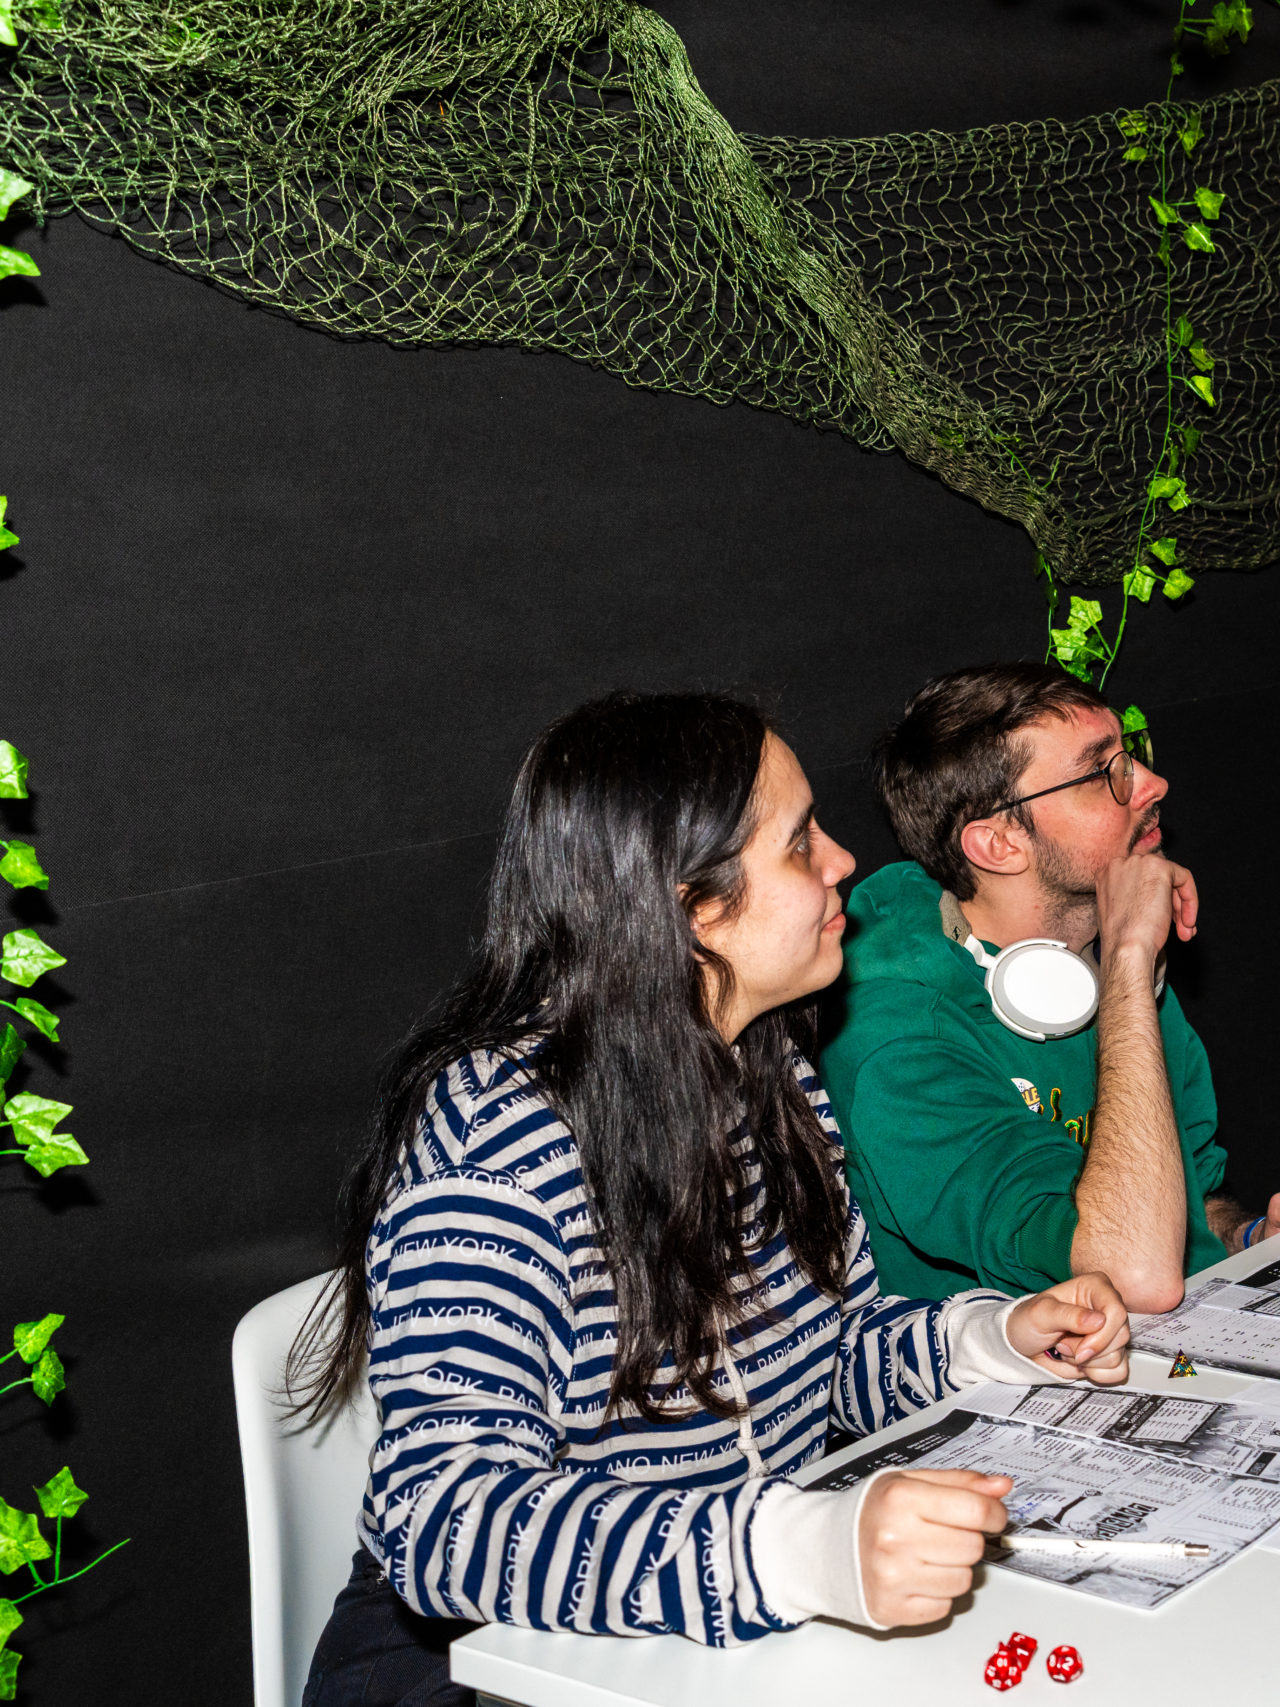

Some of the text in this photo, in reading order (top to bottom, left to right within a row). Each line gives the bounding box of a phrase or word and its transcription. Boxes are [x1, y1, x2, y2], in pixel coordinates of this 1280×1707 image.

[540, 1143, 579, 1168] MILA
[456, 1169, 526, 1199] YORK
[393, 1237, 438, 1262] NEW
[443, 1235, 517, 1264] YORK
[427, 1305, 501, 1333] YORK
[575, 1329, 618, 1351] MILA
[757, 1342, 794, 1371] PARIS
[797, 1311, 840, 1346] MILANO
[423, 1366, 484, 1395] ORK
[661, 1447, 715, 1474] NEW
[657, 1488, 700, 1539] PAR
[502, 1520, 533, 1606] YORK
[564, 1537, 599, 1623] YORK
[712, 1610, 728, 1648] EW
